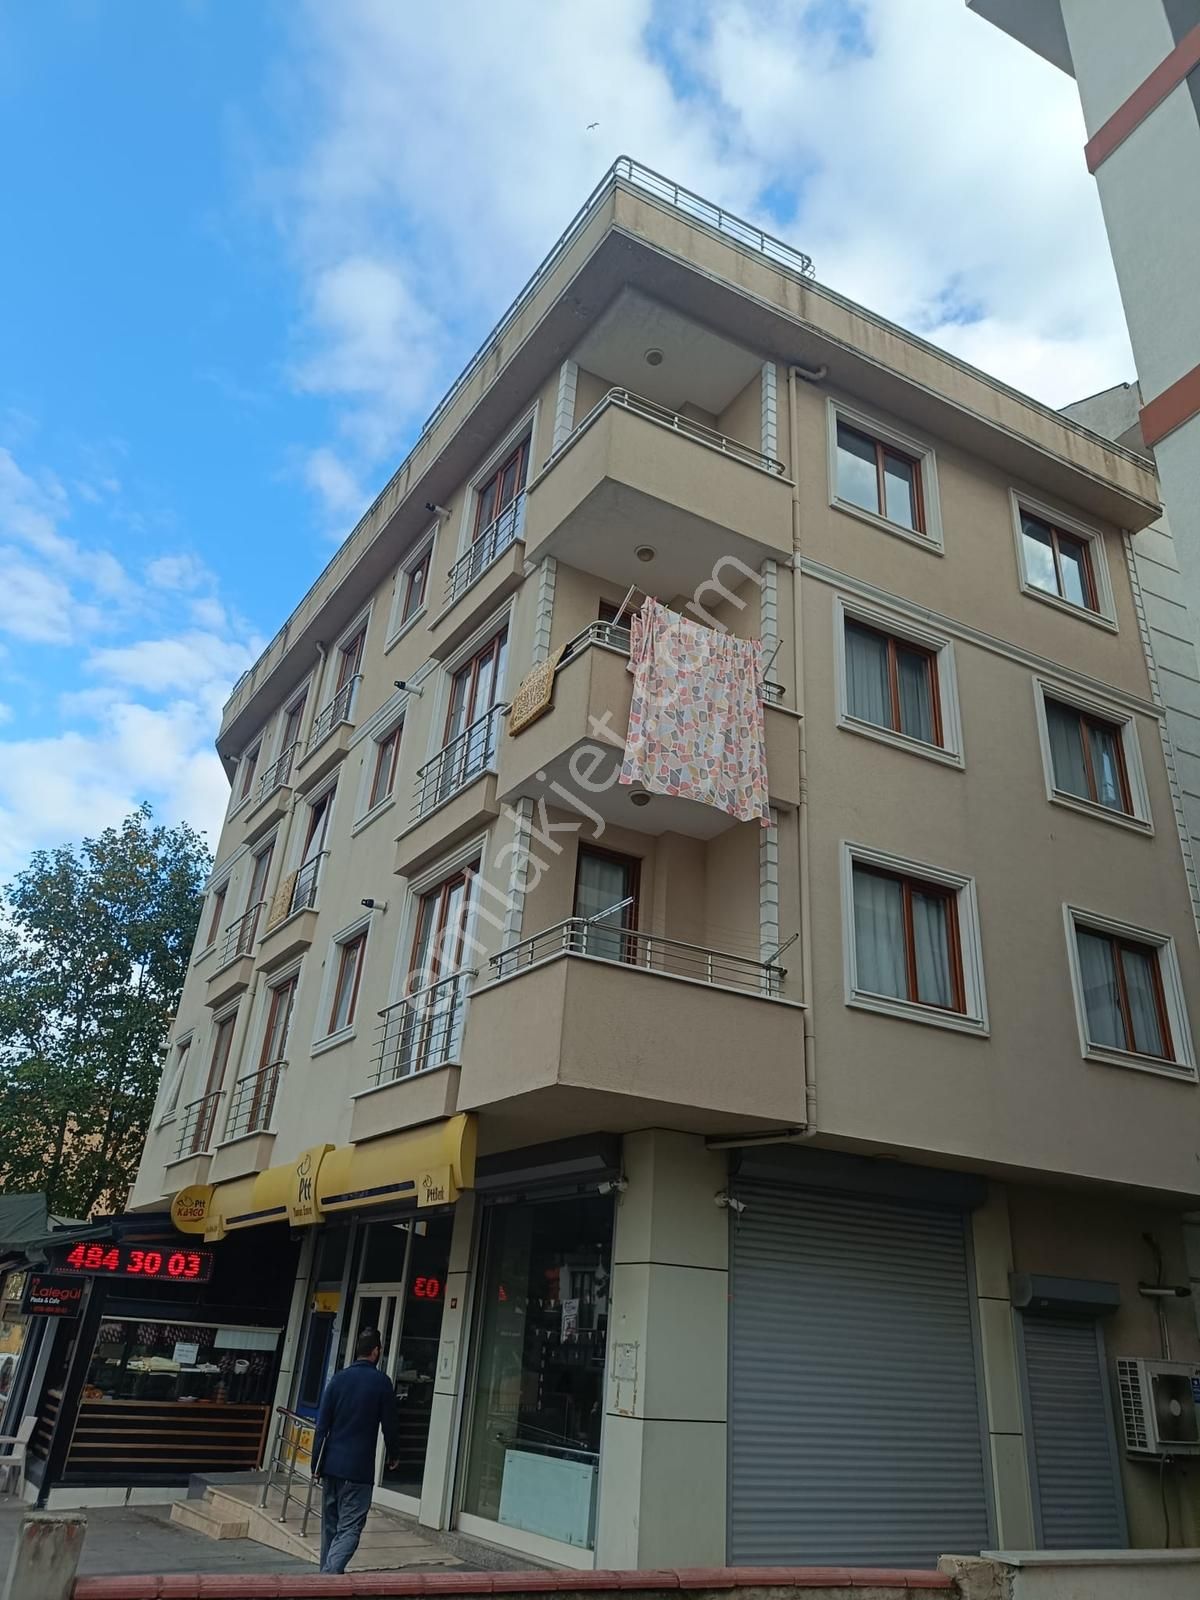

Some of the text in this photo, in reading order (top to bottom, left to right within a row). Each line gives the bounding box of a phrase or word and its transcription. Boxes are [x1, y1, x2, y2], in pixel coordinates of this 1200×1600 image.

[298, 1177, 311, 1202] Ptt
[194, 1199, 206, 1208] Ptt
[67, 1245, 200, 1277] 484 30 03
